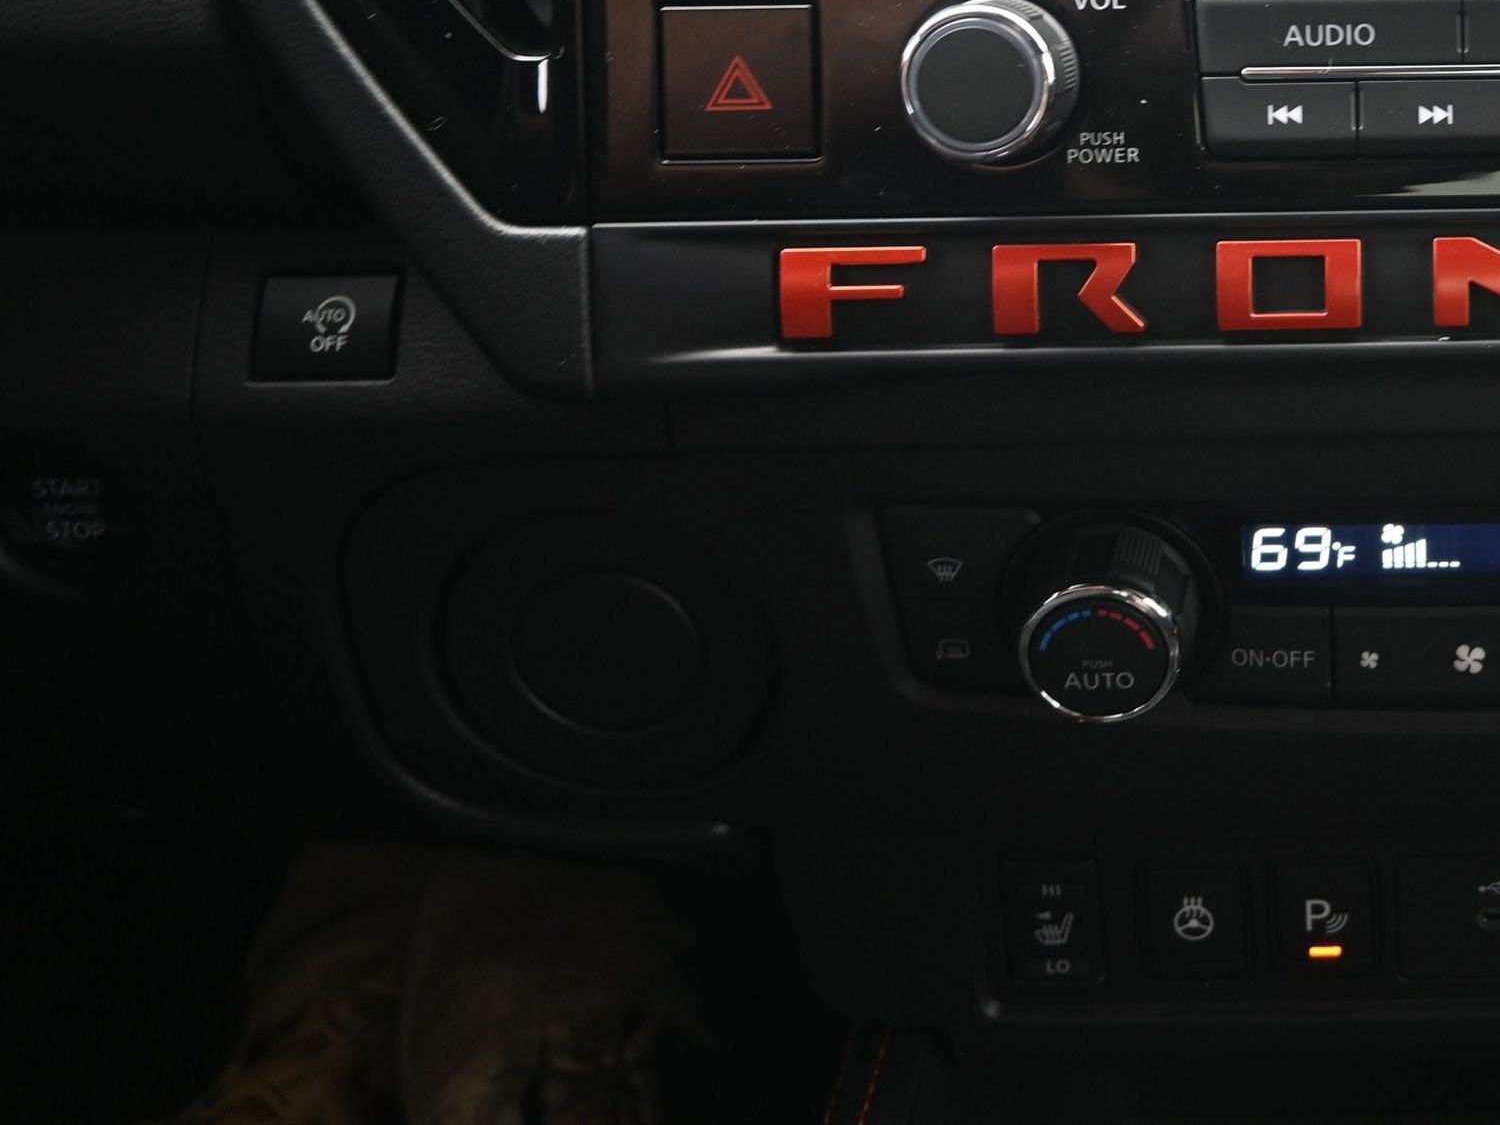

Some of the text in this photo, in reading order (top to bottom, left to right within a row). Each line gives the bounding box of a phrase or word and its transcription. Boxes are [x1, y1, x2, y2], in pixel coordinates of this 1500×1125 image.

[1283, 23, 1376, 48] AUDIO
[1079, 131, 1126, 148] PUSH
[1066, 147, 1140, 165] POWER
[301, 307, 346, 324] AUTO
[309, 335, 349, 353] OFF
[32, 477, 101, 498] START
[47, 519, 106, 541] STOP
[1081, 659, 1113, 669] PUSH
[1064, 671, 1135, 690] AUTO
[1041, 884, 1062, 897] HI
[1304, 899, 1331, 932] P
[1046, 959, 1071, 974] LO
